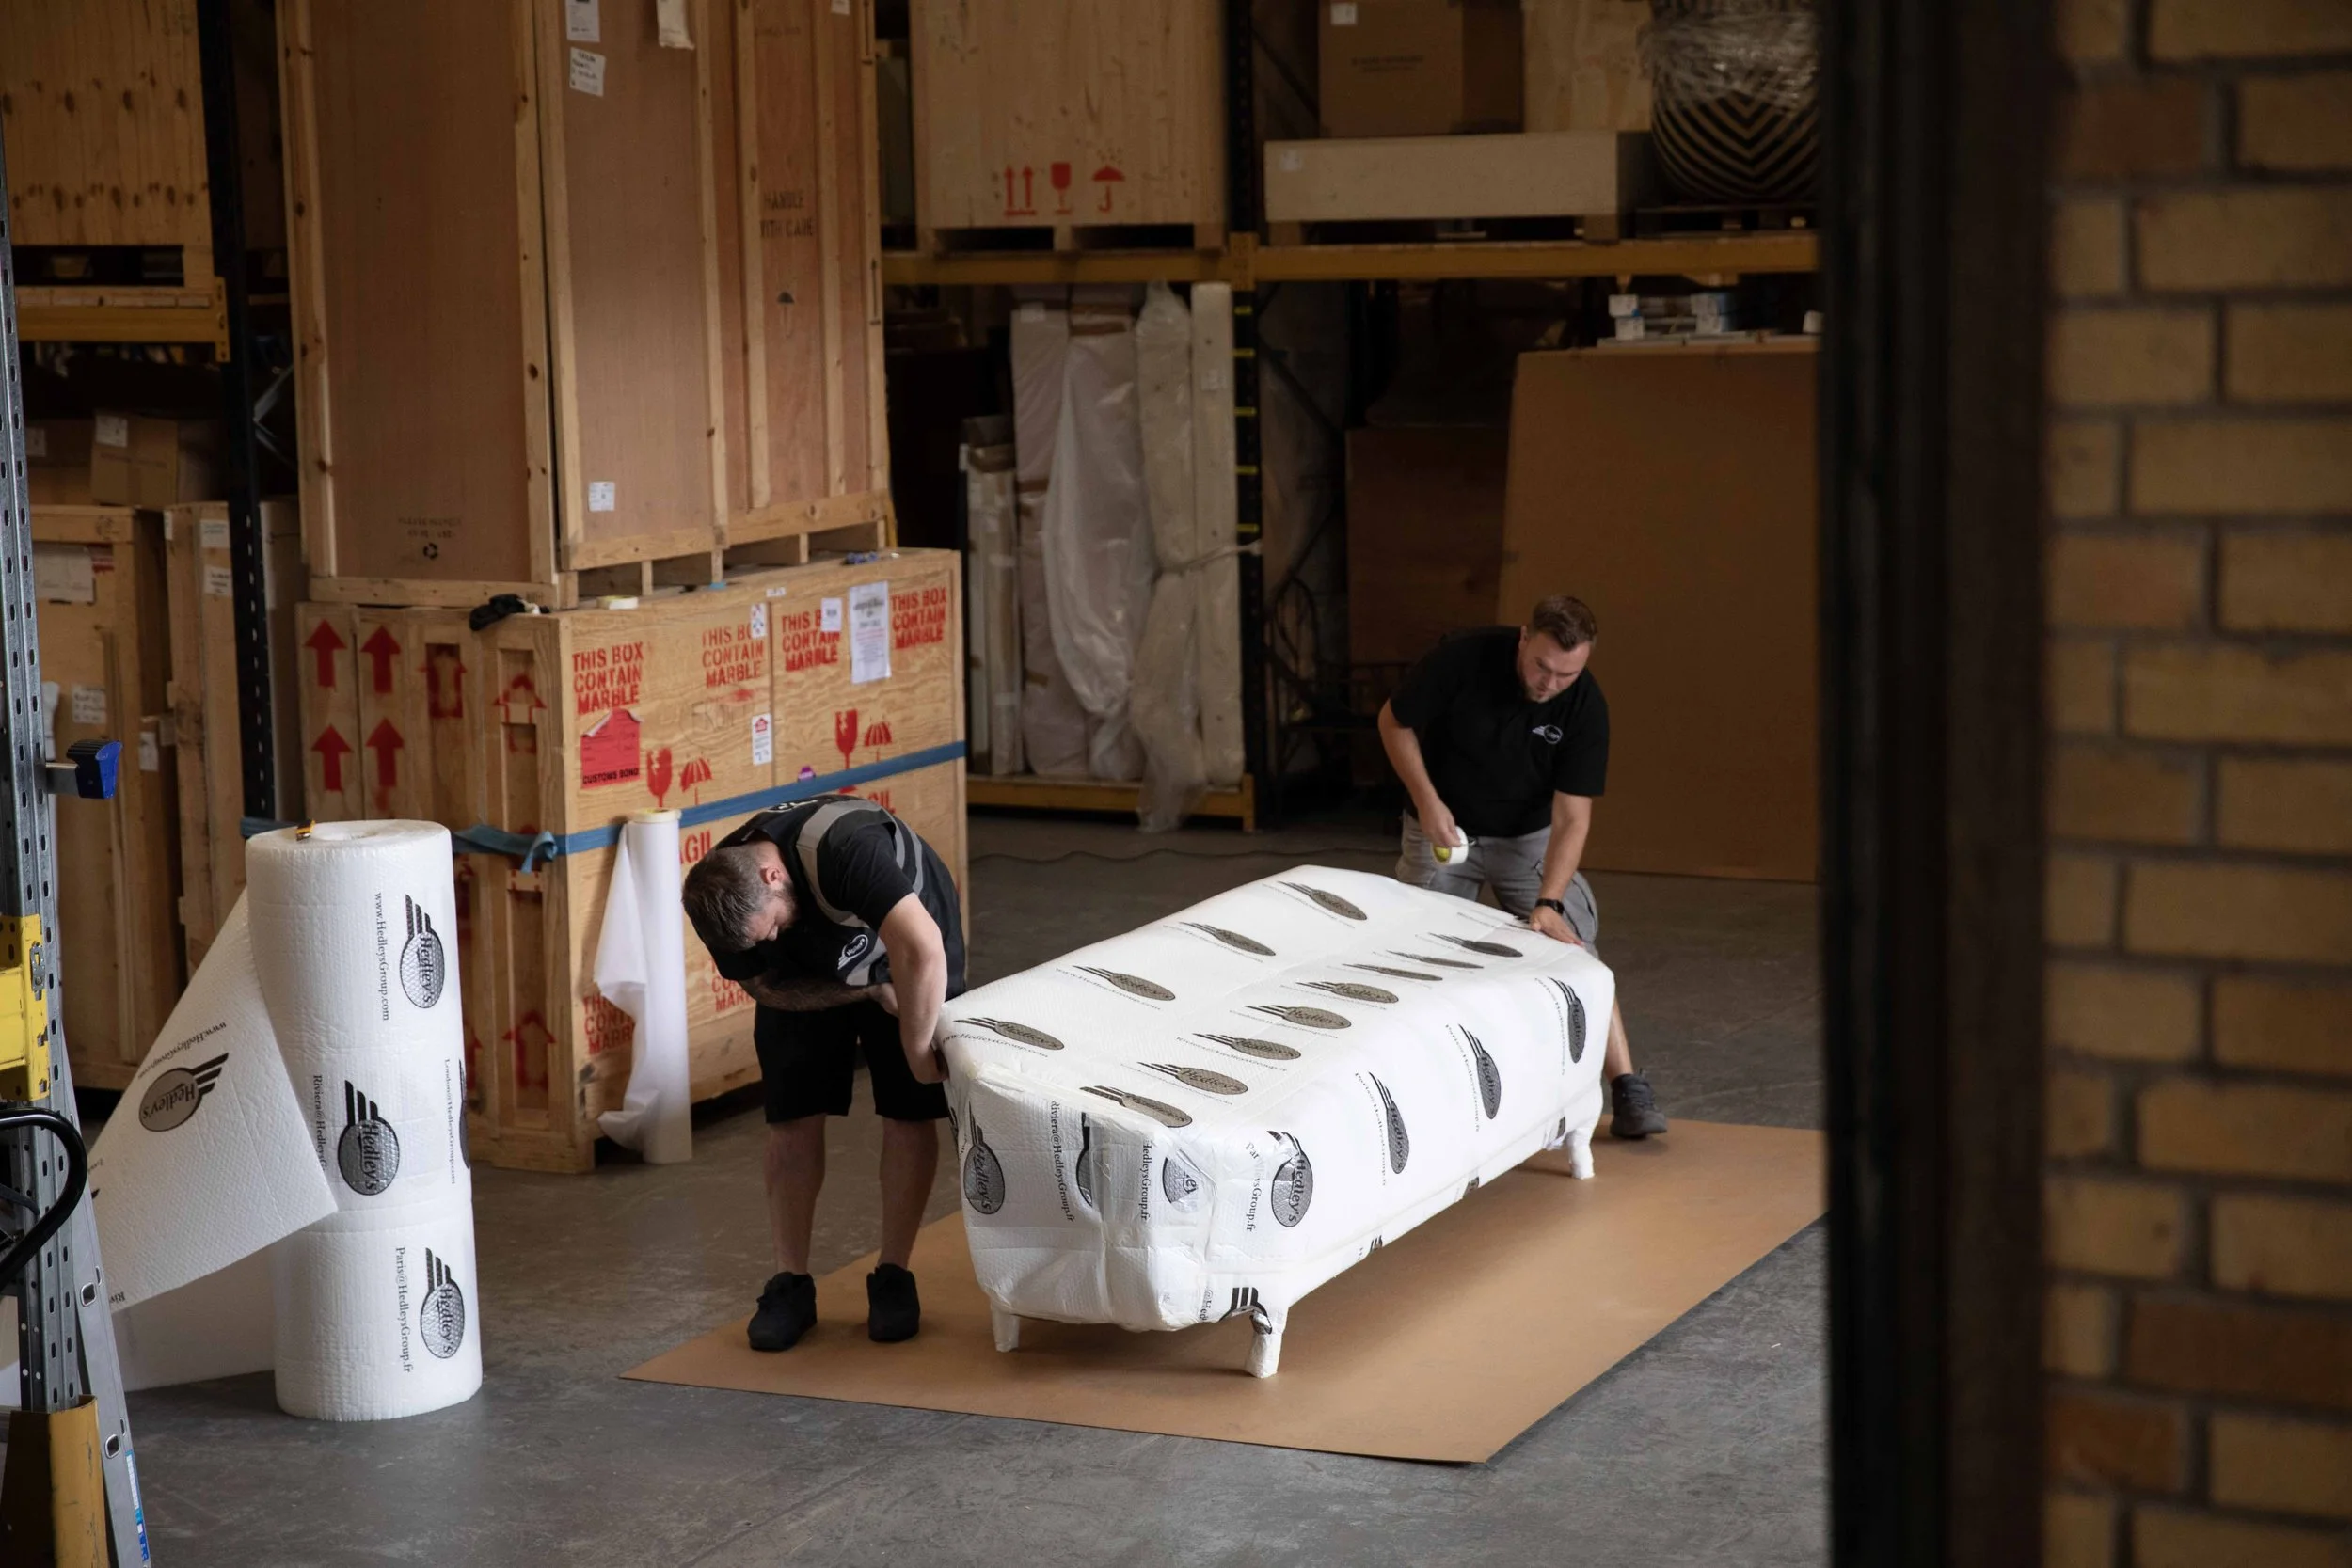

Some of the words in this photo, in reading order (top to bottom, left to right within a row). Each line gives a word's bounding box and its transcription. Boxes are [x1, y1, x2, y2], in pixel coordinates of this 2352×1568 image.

[891, 593, 918, 610] THIS
[923, 587, 946, 605] BOX
[782, 612, 810, 633] THIS
[892, 609, 946, 631] CONTAIN
[702, 626, 731, 646] THIS
[783, 631, 840, 653] CONTAIN
[895, 625, 943, 650] MARBLE
[572, 649, 607, 672] THIS
[612, 641, 644, 664] BOX
[702, 641, 764, 668] CONTAIN
[785, 646, 838, 672] MARBLE
[573, 665, 642, 693] CONTAIN
[707, 661, 761, 688] MARBLE
[577, 685, 639, 715] MARBLE
[582, 770, 617, 784] CUSTOMS
[619, 768, 640, 779] BOND
[374, 892, 389, 1021] www.HedleysGroup.com
[421, 937, 435, 1003] Hedley's
[138, 1022, 227, 1079] www.HedleysGroup.com
[142, 1083, 196, 1119] Hedley's
[360, 1123, 381, 1191] Hedley's
[973, 1147, 992, 1211] Hedley's
[1288, 1159, 1306, 1223] Hedley's
[395, 1246, 414, 1373] Paris@HedleysGroup.fr
[439, 1288, 454, 1354] Hedley's
